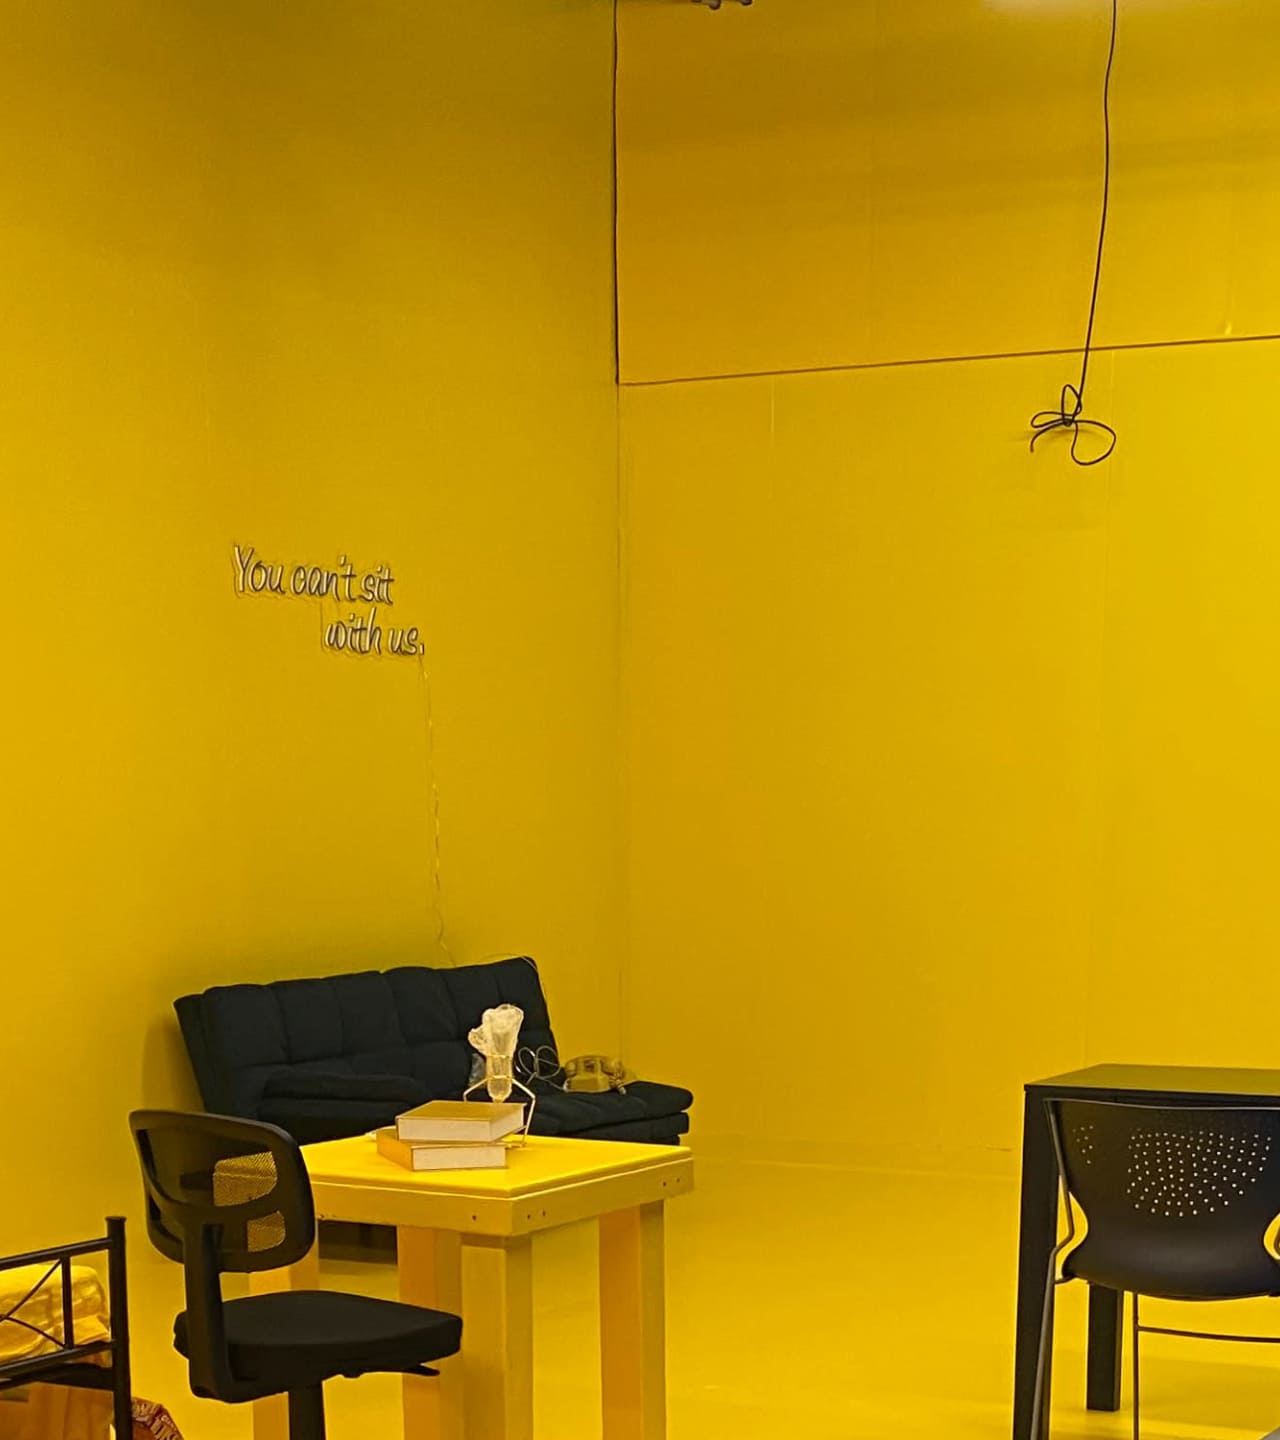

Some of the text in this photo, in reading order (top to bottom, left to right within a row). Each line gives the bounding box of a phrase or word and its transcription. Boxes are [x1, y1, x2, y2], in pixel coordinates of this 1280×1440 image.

[234, 545, 395, 604] You can't sit
[325, 606, 381, 655] with
